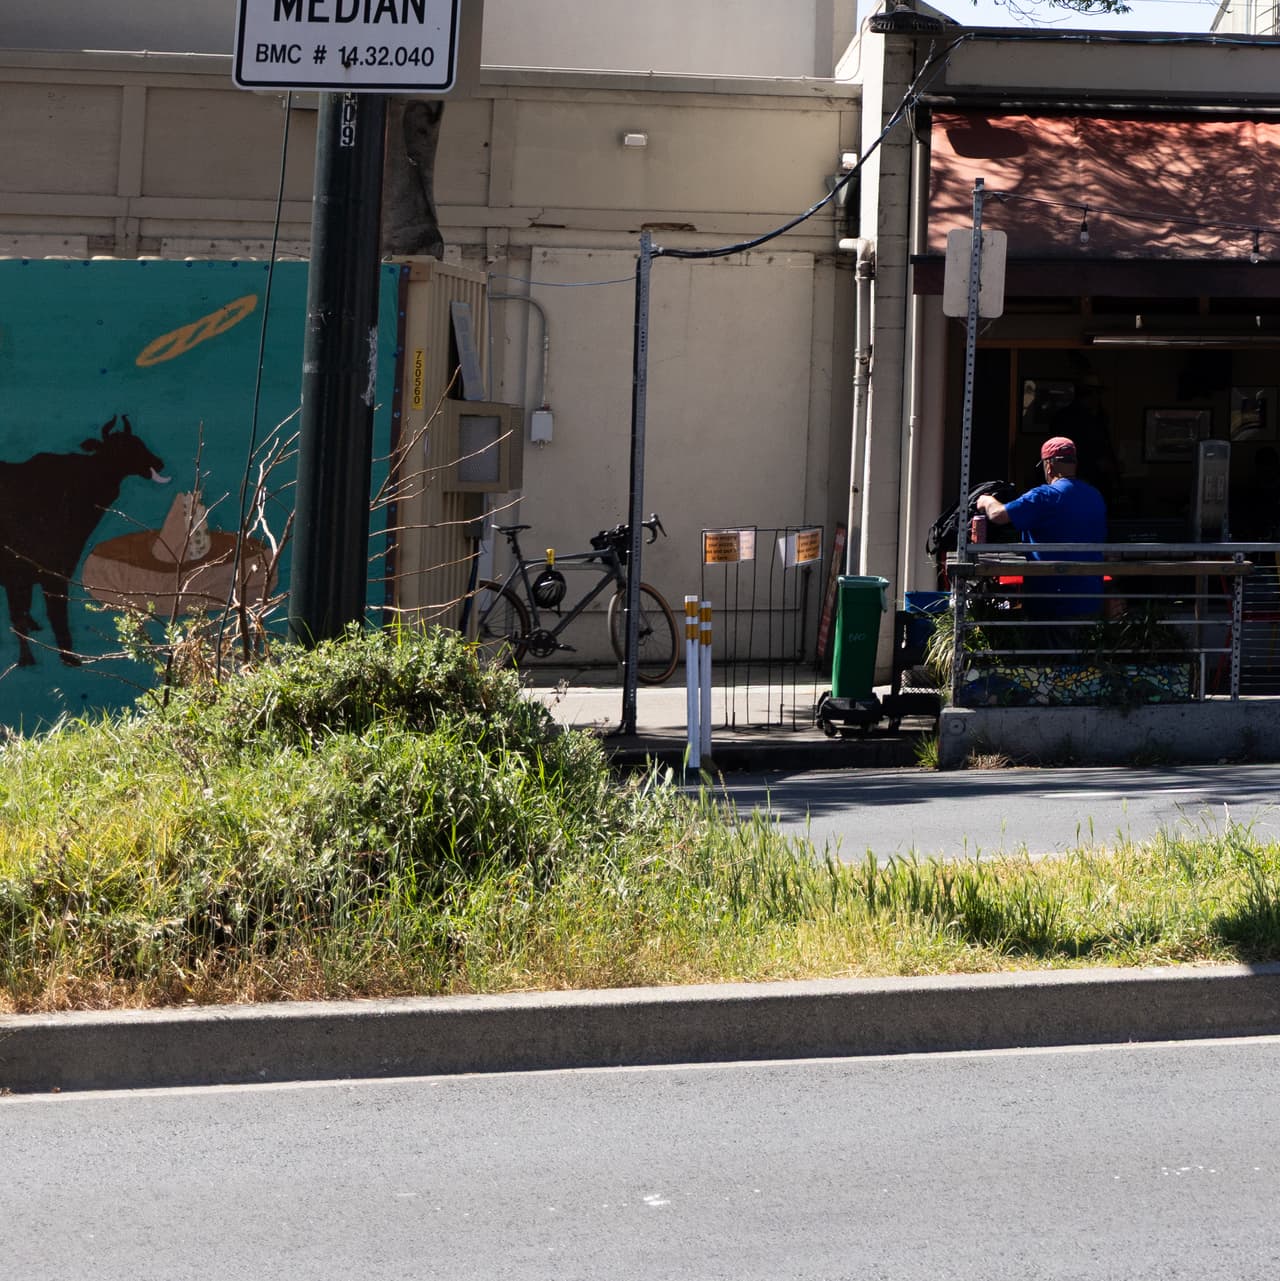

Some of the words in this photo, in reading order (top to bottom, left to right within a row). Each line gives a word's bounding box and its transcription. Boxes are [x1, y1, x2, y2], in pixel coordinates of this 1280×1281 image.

[255, 43, 302, 64] BMC
[312, 45, 328, 65] #
[338, 46, 435, 67] 14.32.040
[414, 350, 423, 404] 750560
